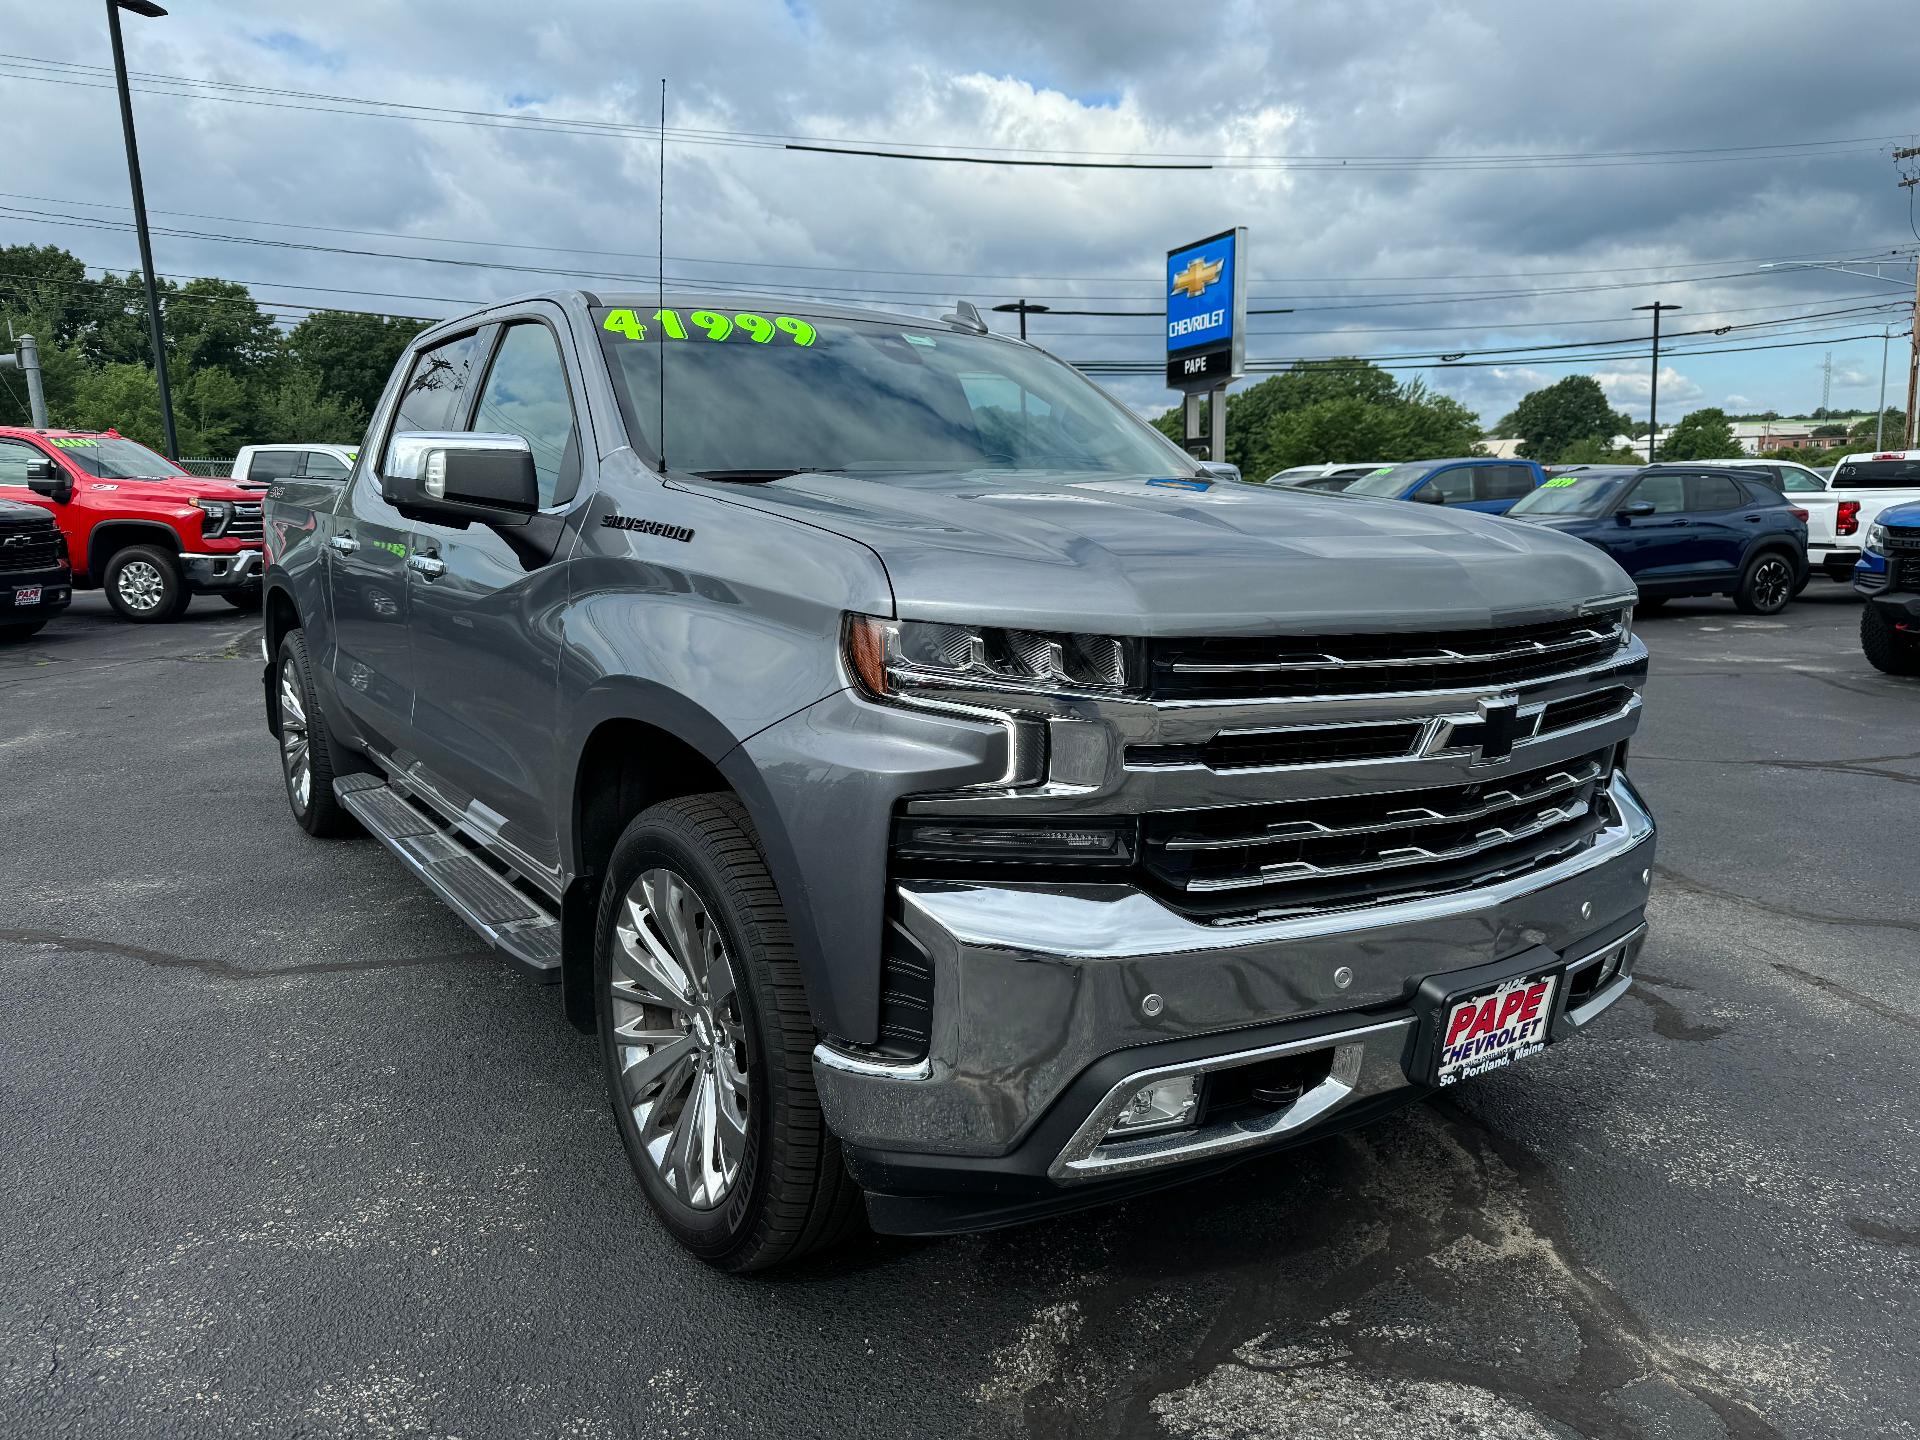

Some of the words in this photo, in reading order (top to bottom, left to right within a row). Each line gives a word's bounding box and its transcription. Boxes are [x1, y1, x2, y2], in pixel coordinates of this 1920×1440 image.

[603, 309, 816, 346] 41999
[1169, 309, 1225, 337] CHEVROLET
[1184, 356, 1207, 375] PAPE
[600, 514, 695, 543] SILVERADO
[17, 590, 40, 599] PAPE
[1495, 976, 1527, 994] PAPE
[1445, 982, 1549, 1048] PAPE
[1441, 1017, 1543, 1067] CHEVROLET
[1440, 1074, 1457, 1087] So.
[1462, 1053, 1510, 1080] Portland,
[1514, 1043, 1545, 1061] Maine
